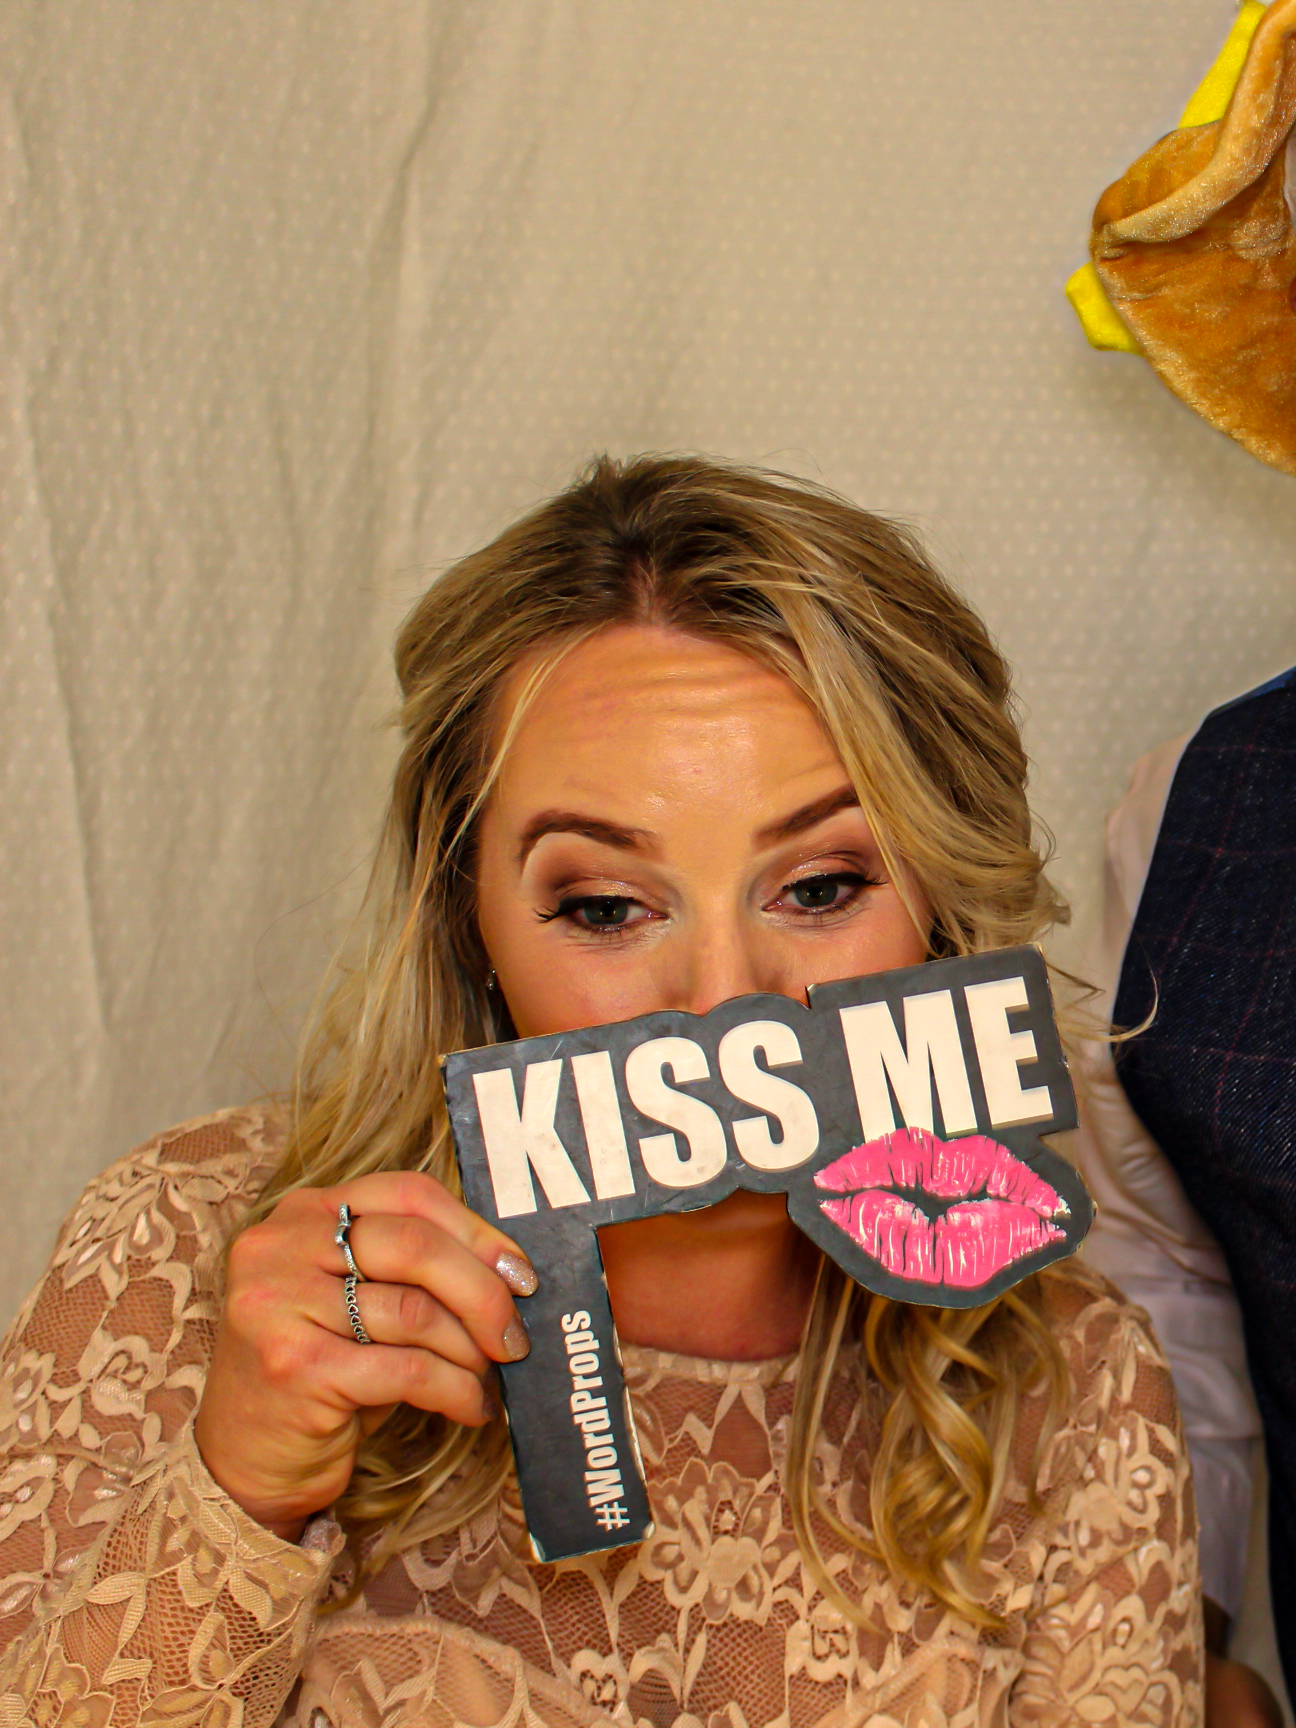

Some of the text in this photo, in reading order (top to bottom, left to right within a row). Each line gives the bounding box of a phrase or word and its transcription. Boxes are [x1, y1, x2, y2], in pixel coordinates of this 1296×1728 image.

[472, 975, 1054, 1219] KISS ME
[561, 1309, 631, 1532] #WordProps
